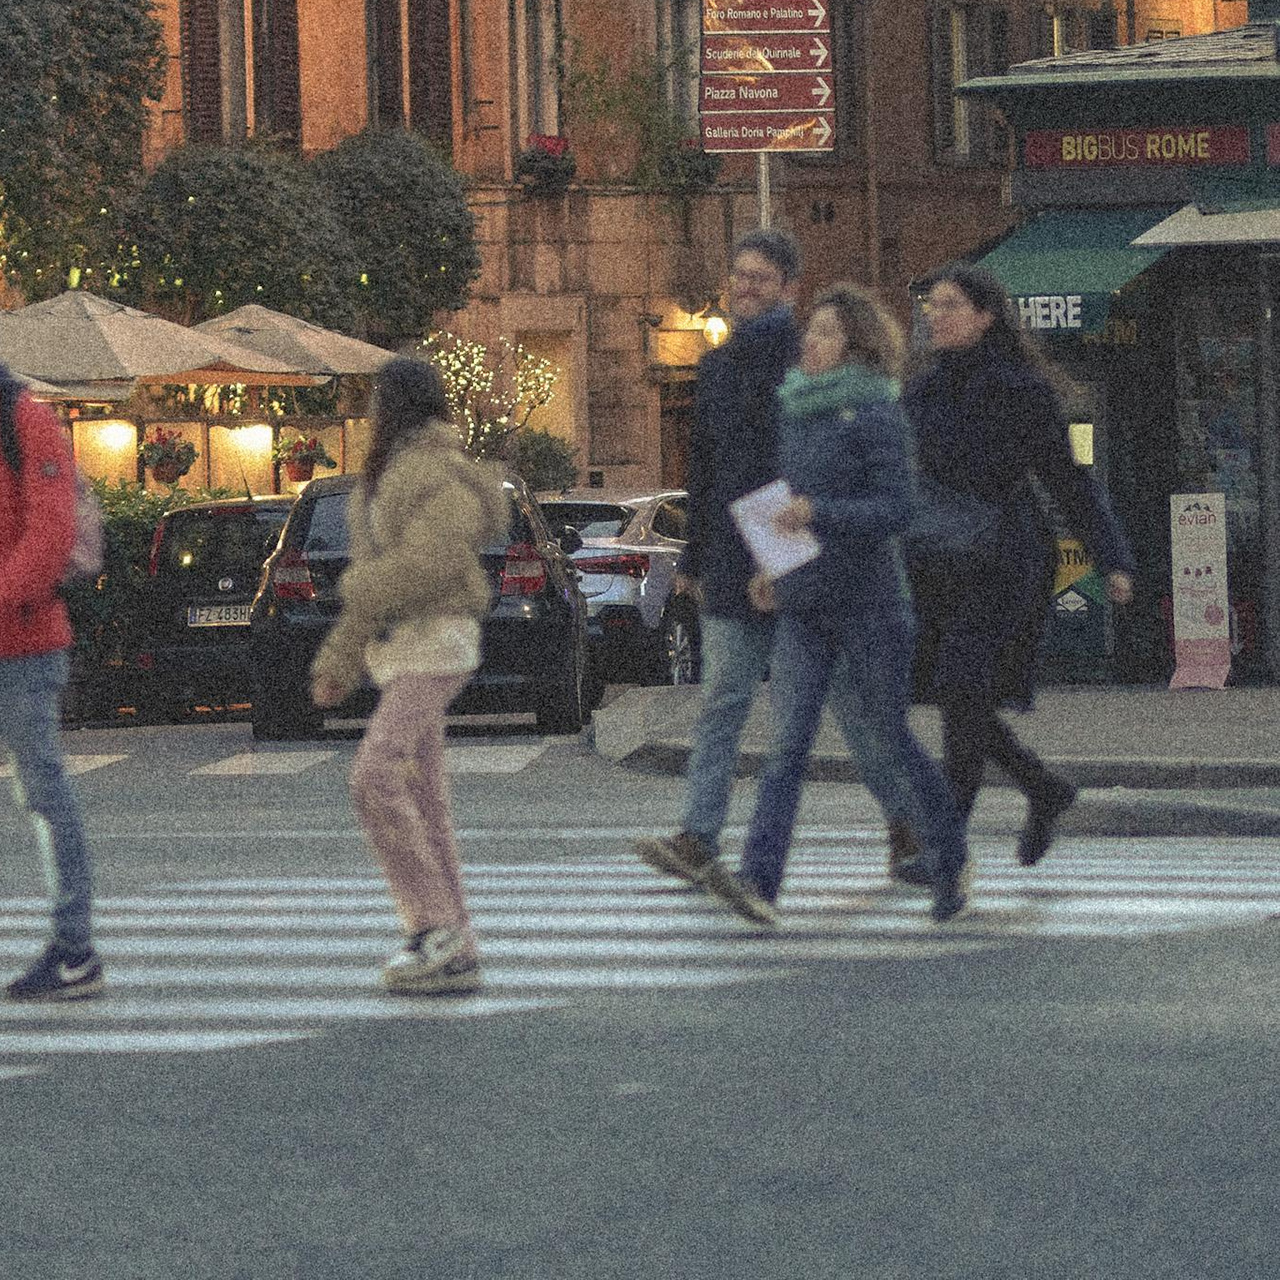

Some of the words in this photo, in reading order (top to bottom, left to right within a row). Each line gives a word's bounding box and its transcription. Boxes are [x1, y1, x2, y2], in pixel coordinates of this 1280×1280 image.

[706, 8, 725, 19] Foro
[727, 8, 761, 19] Romano
[770, 7, 804, 19] Palatino
[705, 48, 745, 59] Scuderie
[762, 46, 801, 59] Quirinale
[705, 87, 736, 99] Piazza
[739, 86, 778, 99] Navona
[705, 126, 739, 138] Galleria
[741, 126, 764, 138] Doria
[1146, 132, 1211, 160] ROME
[1018, 295, 1082, 329] HERE
[1178, 512, 1217, 526] evian
